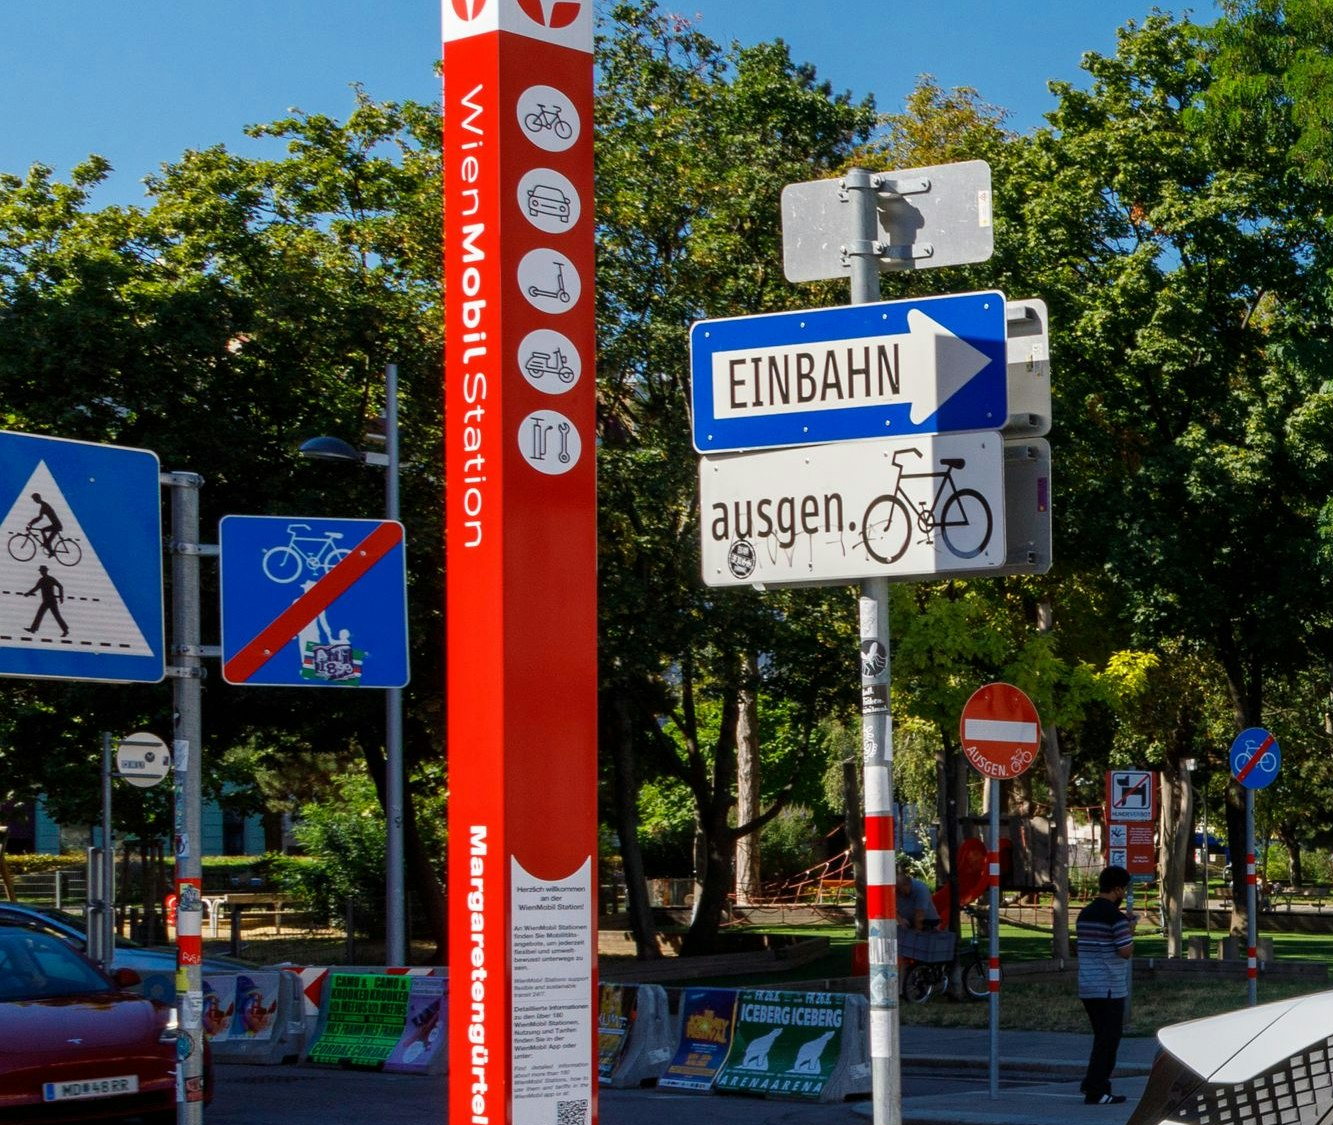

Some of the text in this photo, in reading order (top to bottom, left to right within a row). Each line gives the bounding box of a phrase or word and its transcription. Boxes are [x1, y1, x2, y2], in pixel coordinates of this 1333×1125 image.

[460, 83, 487, 549] WienMobil Station
[729, 344, 900, 409] EINBAHN
[712, 493, 856, 549] ausgen.
[967, 746, 1009, 776] AUSGEN.
[467, 825, 488, 1125] Margaretengürtel
[741, 1004, 791, 1025] ICEBERG
[792, 1007, 842, 1028] ICEBERG
[719, 1075, 769, 1089] ARENA
[770, 1079, 823, 1092] ARENA
